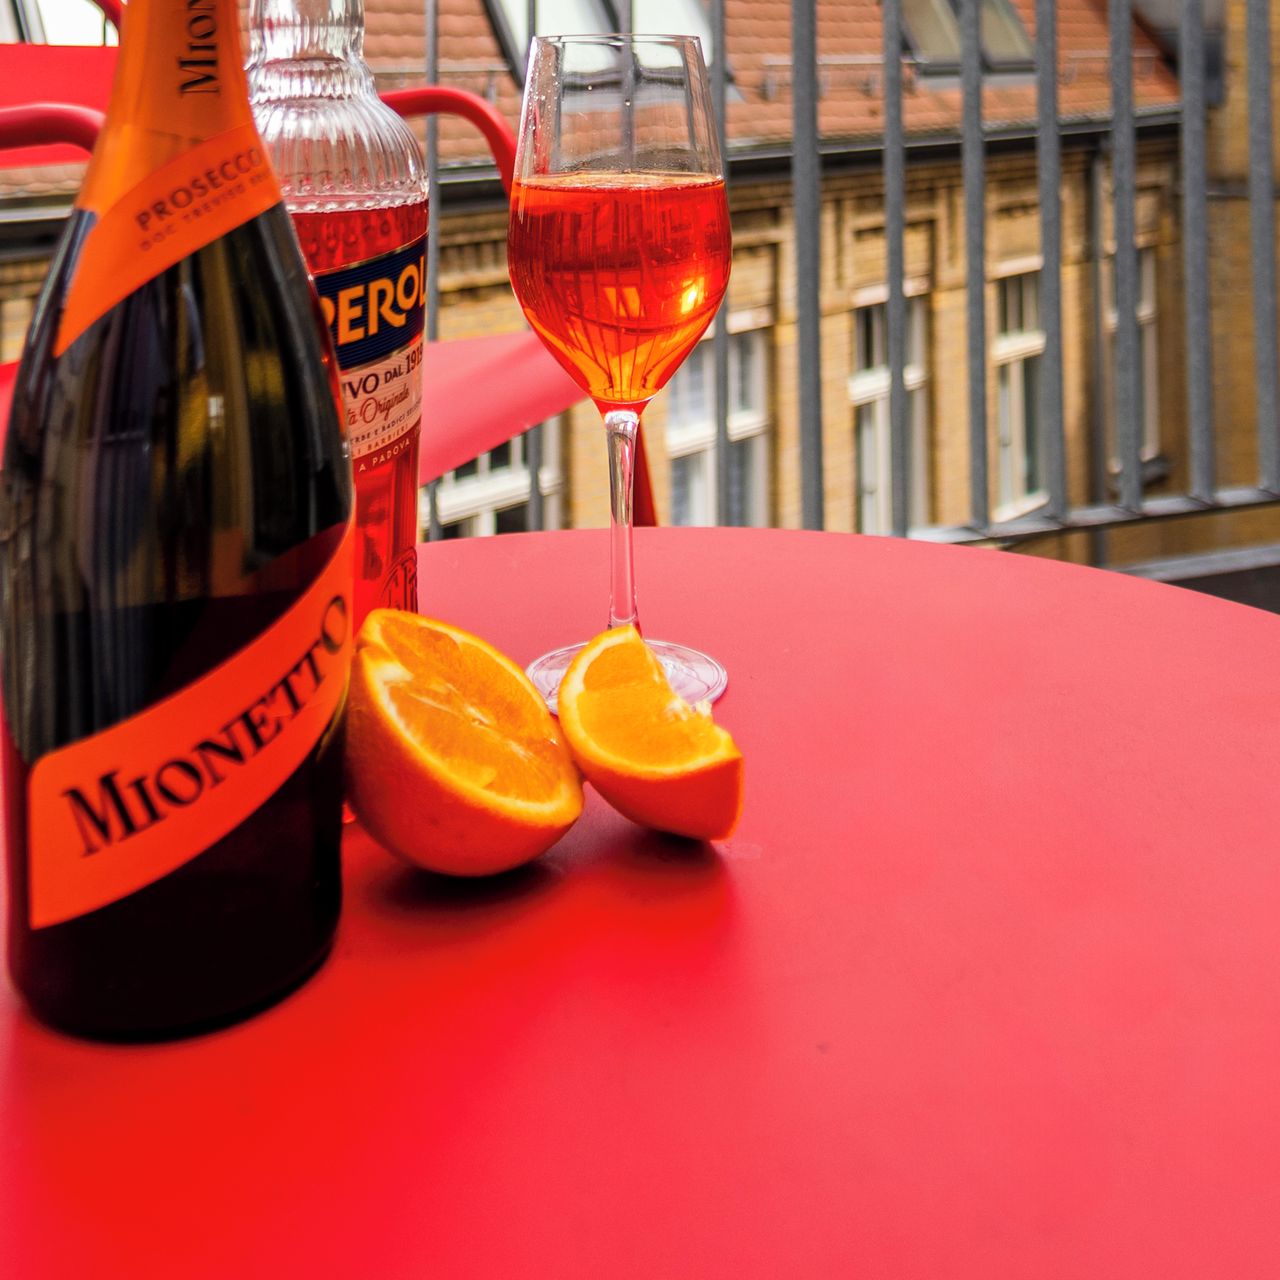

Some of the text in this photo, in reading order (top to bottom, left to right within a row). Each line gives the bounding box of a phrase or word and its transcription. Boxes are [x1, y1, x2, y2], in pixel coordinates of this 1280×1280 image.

[136, 148, 261, 231] PROSECCO
[384, 365, 405, 384] DAL
[360, 383, 410, 422] Originale
[359, 438, 410, 472] A PADOVA
